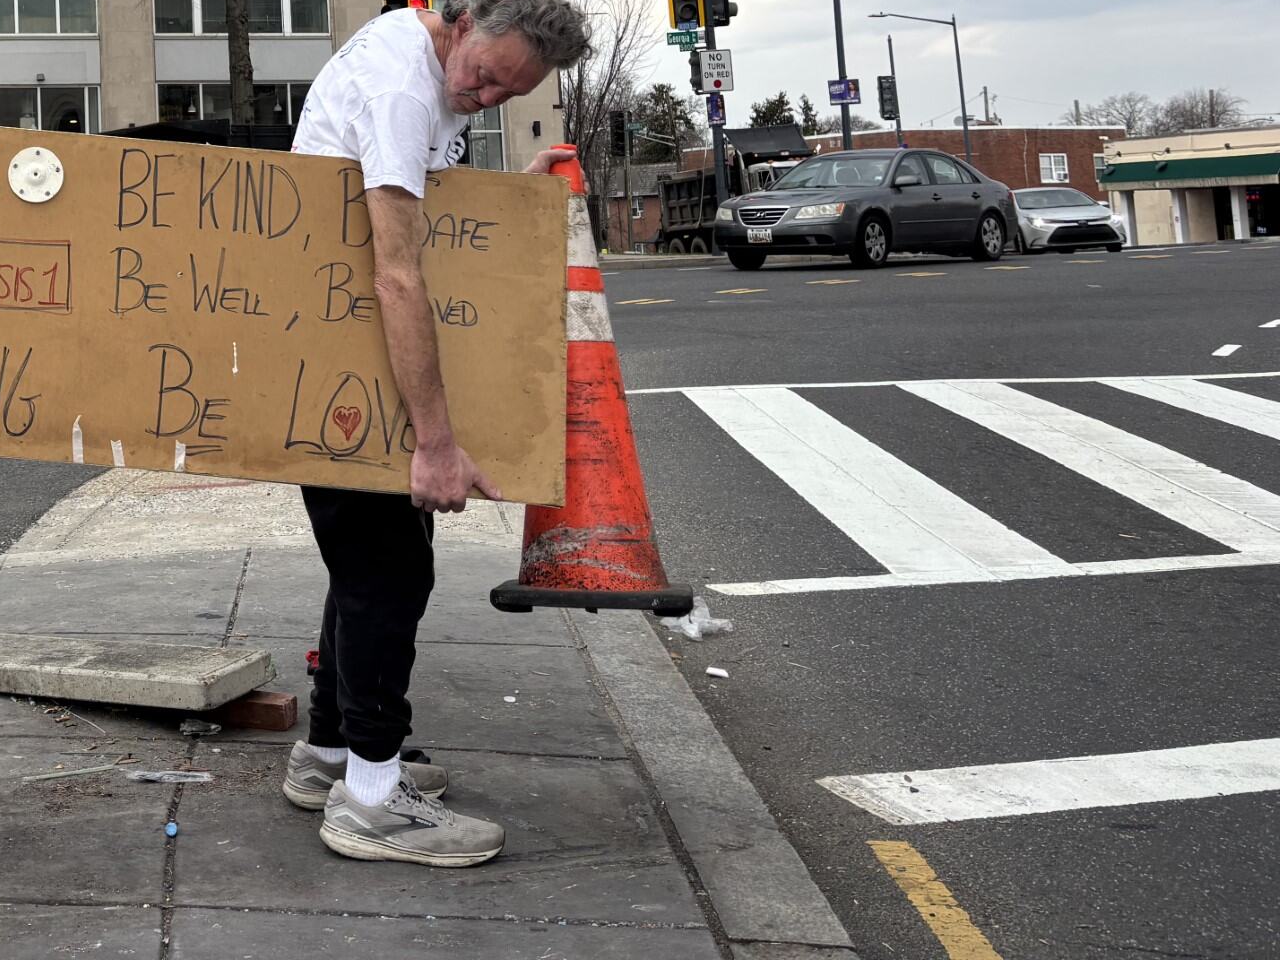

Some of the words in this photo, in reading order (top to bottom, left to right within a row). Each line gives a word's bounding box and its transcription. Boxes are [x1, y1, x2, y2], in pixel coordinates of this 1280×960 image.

[668, 33, 690, 44] Georgia
[708, 53, 723, 62] NO
[707, 62, 726, 71] TURN
[703, 71, 715, 79] ON
[716, 70, 730, 79] RED
[114, 148, 177, 232] BE
[337, 167, 373, 248] B
